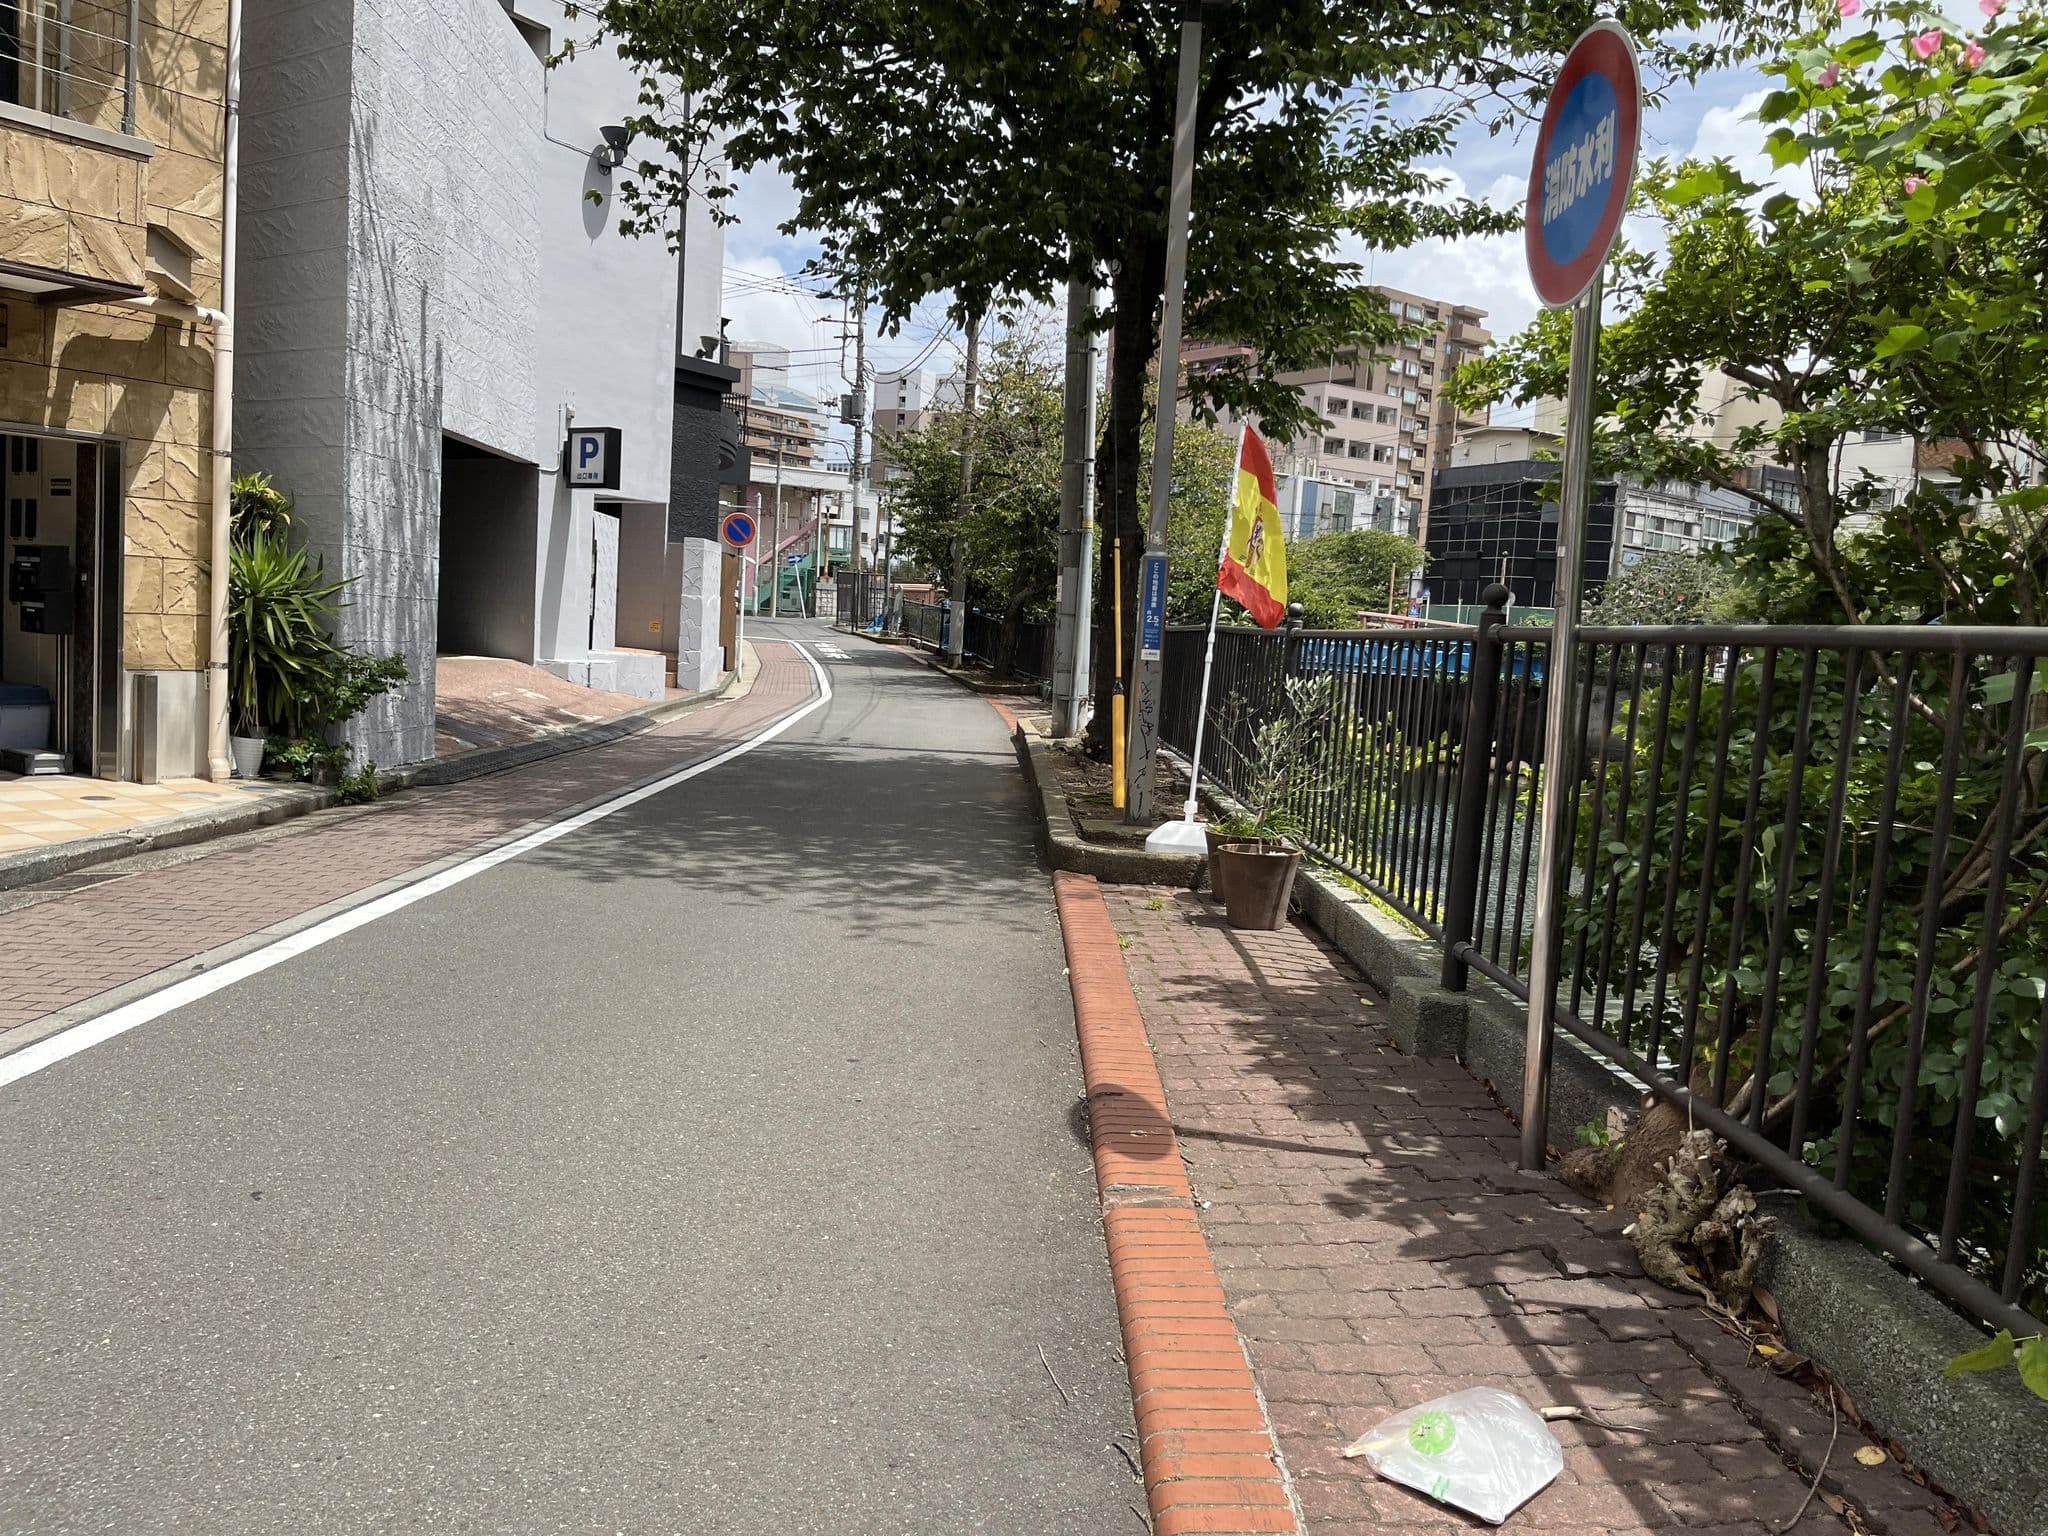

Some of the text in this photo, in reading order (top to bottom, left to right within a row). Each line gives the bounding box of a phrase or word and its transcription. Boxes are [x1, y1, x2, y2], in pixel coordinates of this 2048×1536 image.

[1543, 109, 1615, 226] 消防水利
[579, 437, 599, 468] P
[1146, 615, 1159, 623] 2.5
